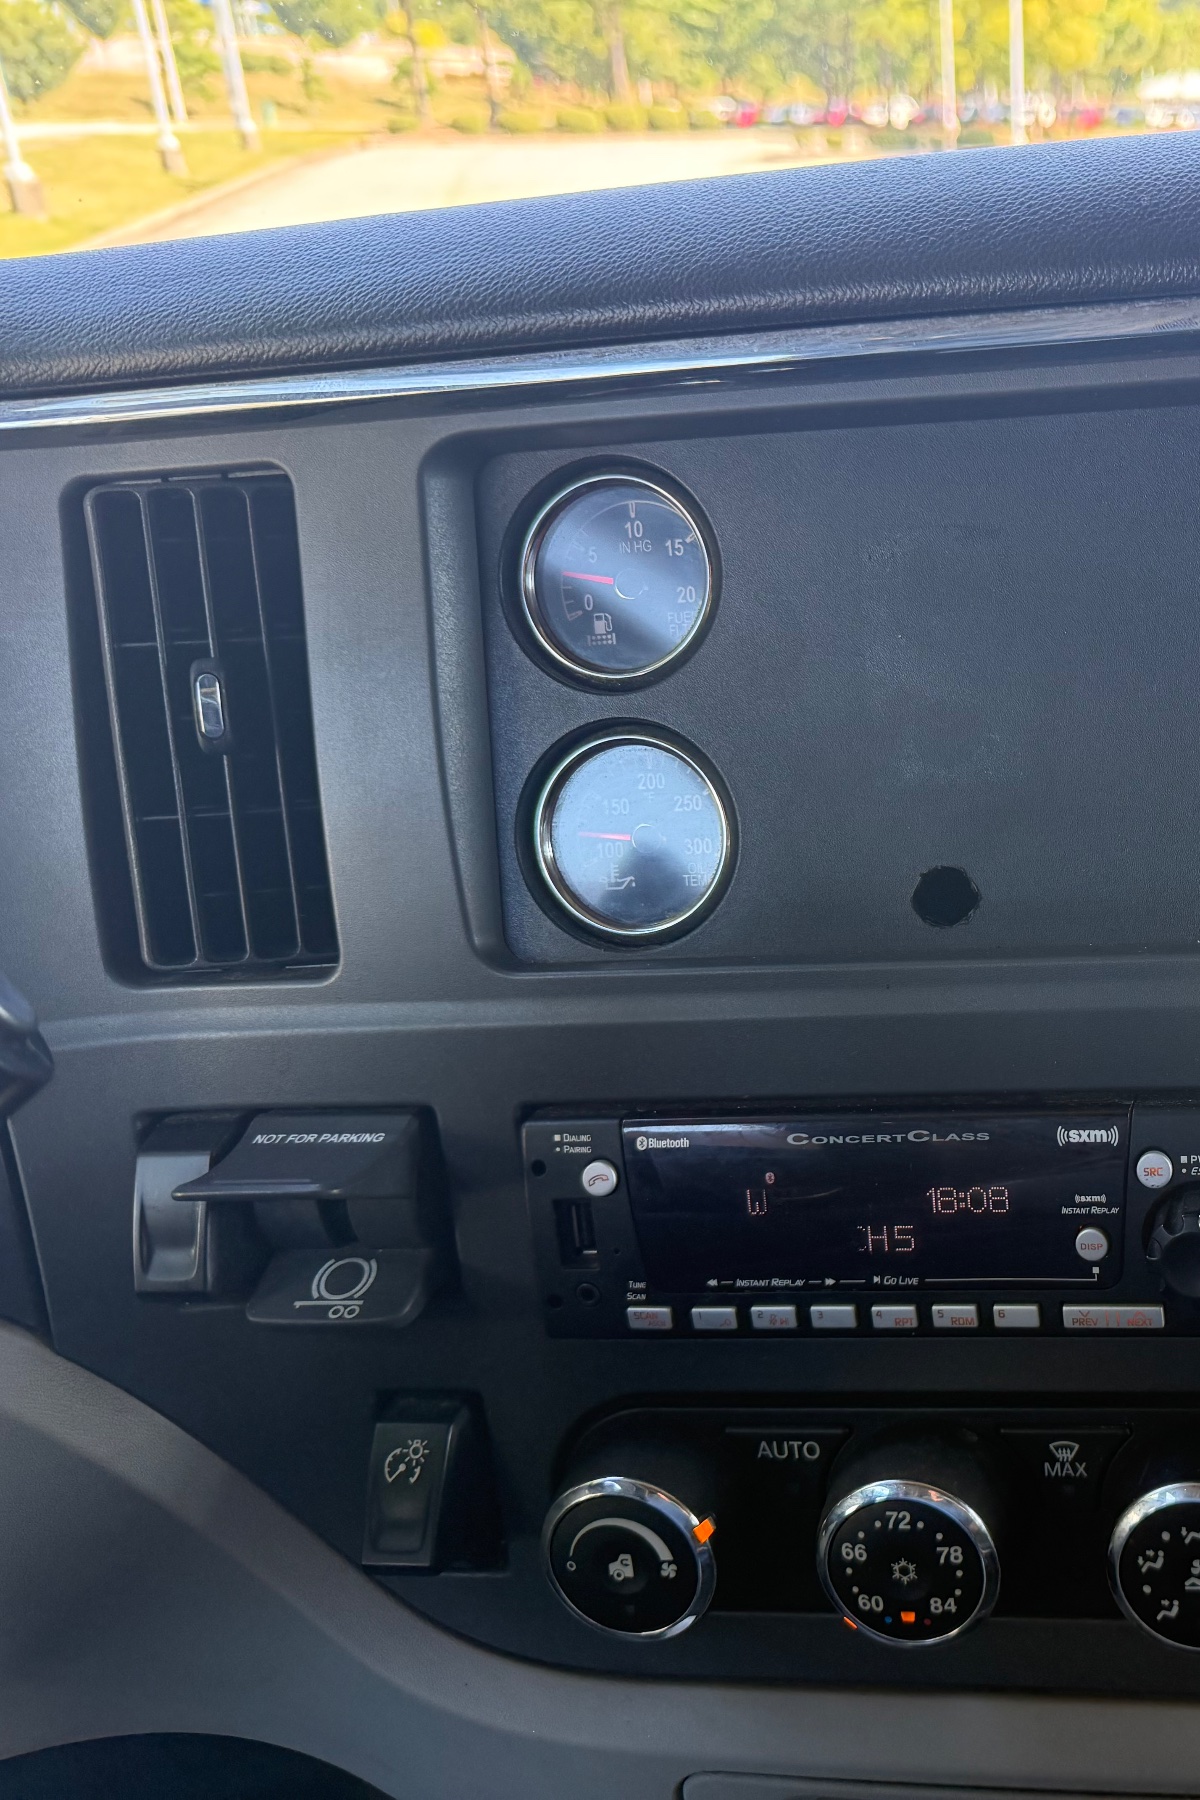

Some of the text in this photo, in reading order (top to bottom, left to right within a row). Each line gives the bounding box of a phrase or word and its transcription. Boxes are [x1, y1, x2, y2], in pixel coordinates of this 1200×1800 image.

[624, 521, 643, 538] 10
[619, 541, 652, 553] IN HG
[665, 539, 684, 556] 15
[588, 549, 597, 563] 5
[584, 594, 593, 610] 0
[676, 586, 696, 603] 20
[637, 773, 665, 789] 200
[603, 799, 629, 815] 150
[674, 795, 702, 811] 250
[597, 842, 623, 858] 100
[684, 838, 712, 854] 300
[688, 862, 706, 873] OIL
[252, 1133, 386, 1144] NOT FOR PARKING
[648, 1137, 690, 1149] Bluetooth
[1143, 1167, 1164, 1177] SRC
[926, 1186, 1009, 1213] 18:08
[757, 1311, 764, 1319] 2
[816, 1311, 824, 1319] 3
[875, 1311, 882, 1319] 4
[894, 1318, 914, 1326] RPT
[937, 1310, 944, 1318] 5
[998, 1310, 1006, 1318] 6
[1072, 1318, 1098, 1326] PREV
[1127, 1318, 1153, 1326] NEXT
[758, 1441, 820, 1459] AUTO
[1044, 1461, 1087, 1477] MAX
[885, 1511, 911, 1529] 72
[841, 1543, 867, 1560] 66
[936, 1546, 963, 1564] 78
[857, 1594, 884, 1611] 60
[930, 1598, 957, 1613] 84
